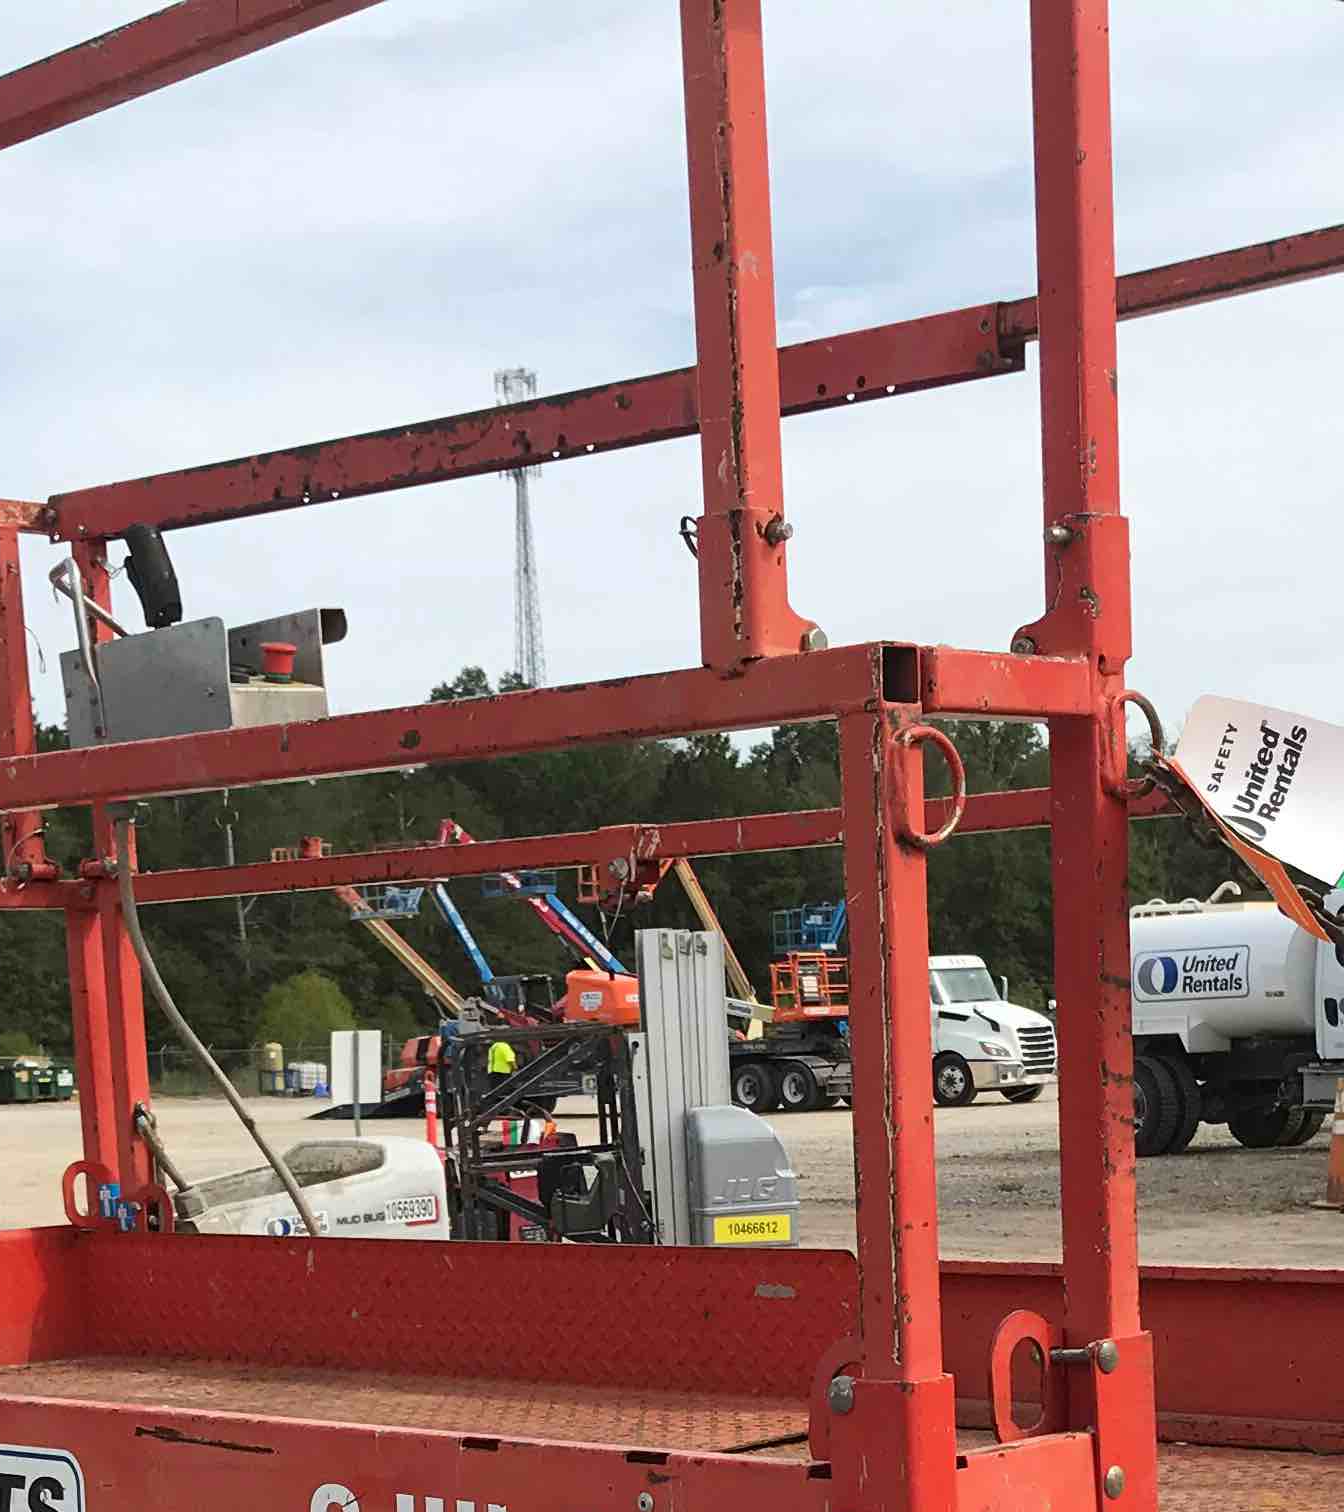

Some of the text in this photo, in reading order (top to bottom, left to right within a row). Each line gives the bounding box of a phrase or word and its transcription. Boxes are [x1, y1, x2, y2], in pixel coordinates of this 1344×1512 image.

[1207, 722, 1239, 793] SAFETY
[1232, 724, 1281, 814] United
[1258, 724, 1308, 822] Rentals
[1182, 952, 1240, 974] United
[1182, 973, 1243, 994] Rentals
[336, 1214, 362, 1225] MUD
[385, 1197, 434, 1223] 10569390
